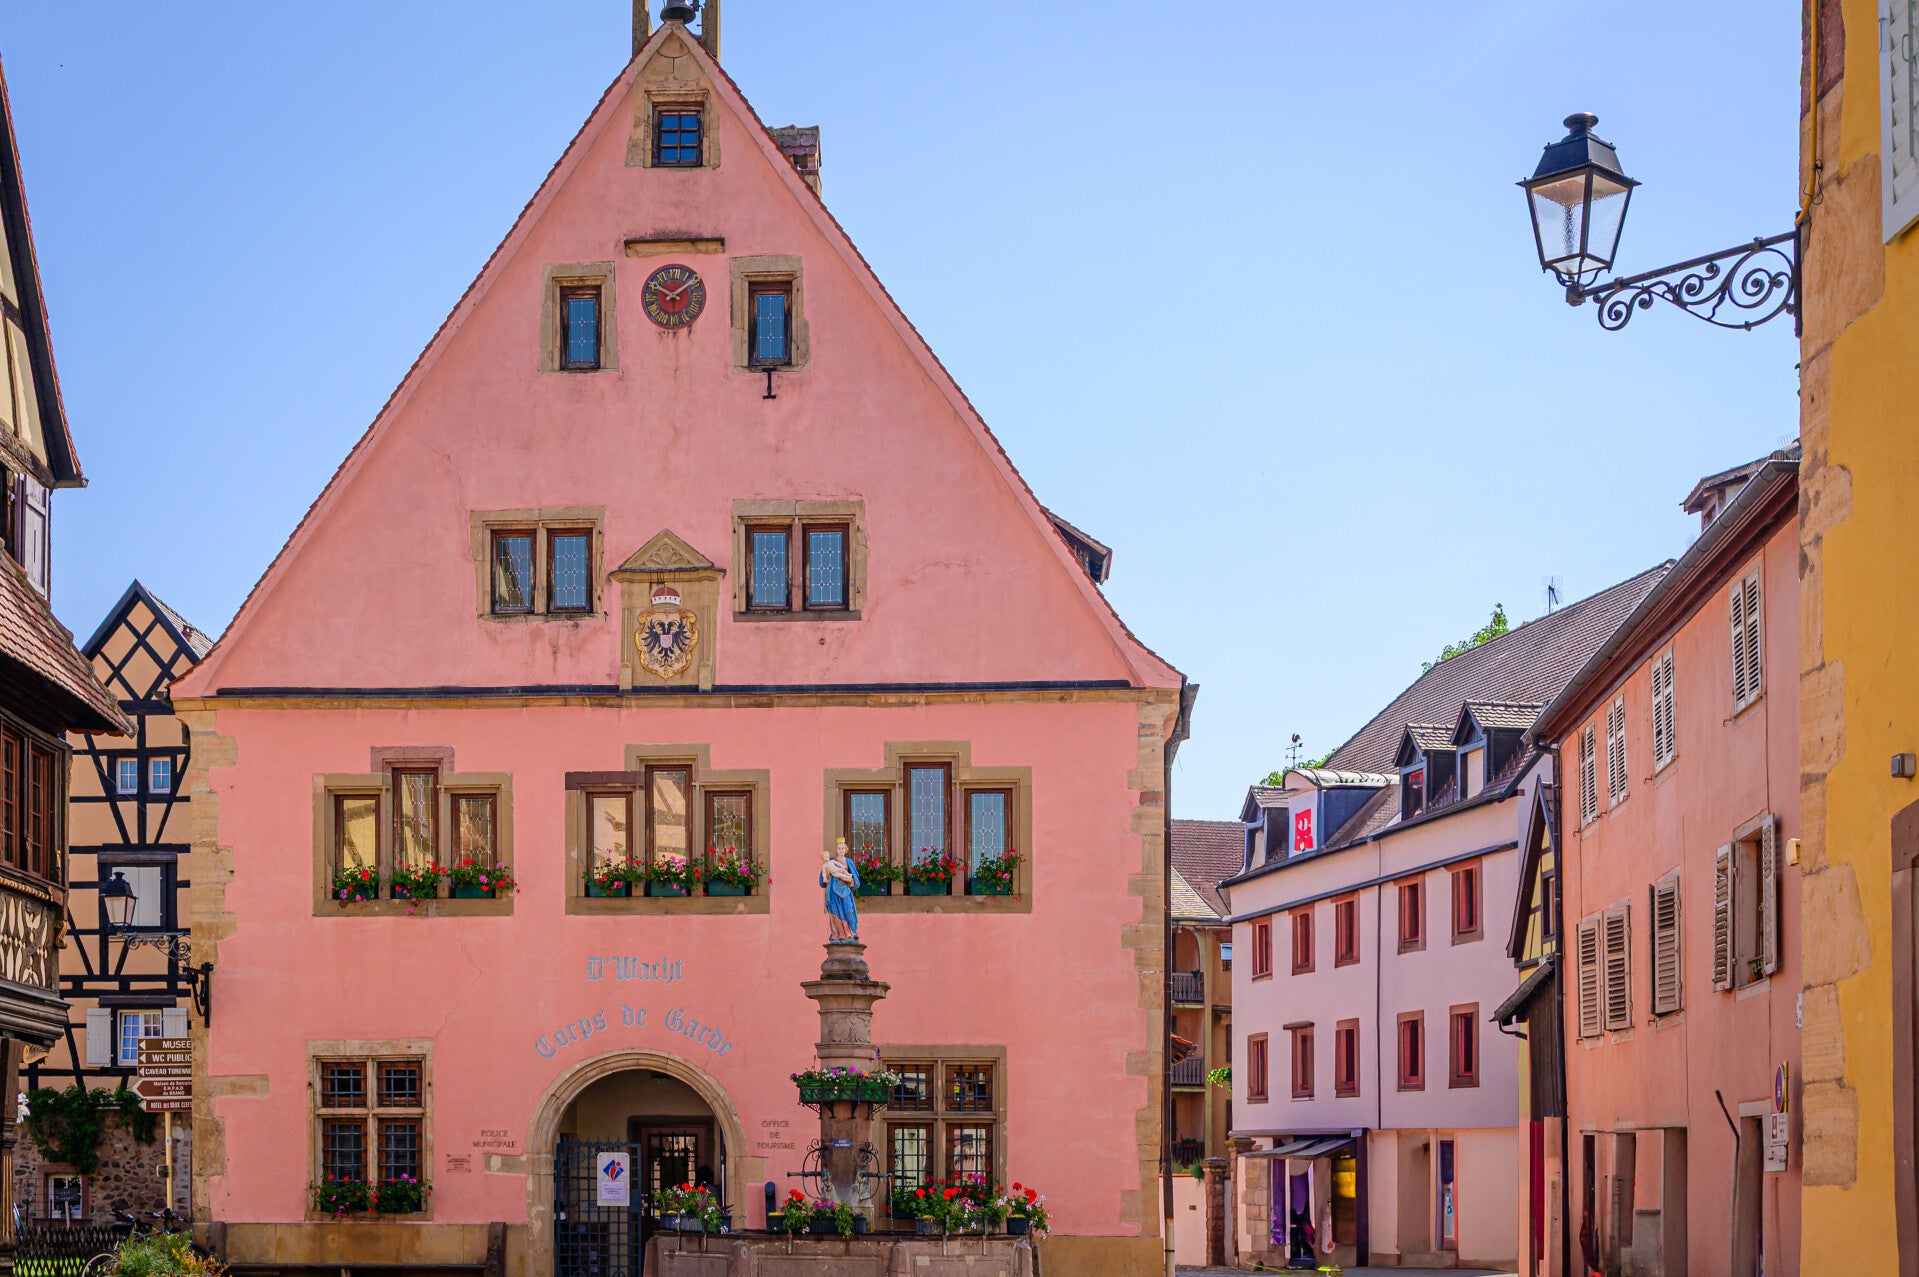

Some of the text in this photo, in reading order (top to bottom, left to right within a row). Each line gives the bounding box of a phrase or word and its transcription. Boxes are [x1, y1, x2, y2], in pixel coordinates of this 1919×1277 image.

[586, 956, 683, 985] D'Wacht
[535, 1001, 733, 1059] Corps de Garde
[152, 1054, 165, 1062] WC
[761, 1120, 790, 1128] OFFICE
[480, 1129, 509, 1138] POLICE
[769, 1131, 781, 1139] DE
[472, 1140, 517, 1148] MUNICIPALE
[756, 1142, 796, 1150] TOURISME
